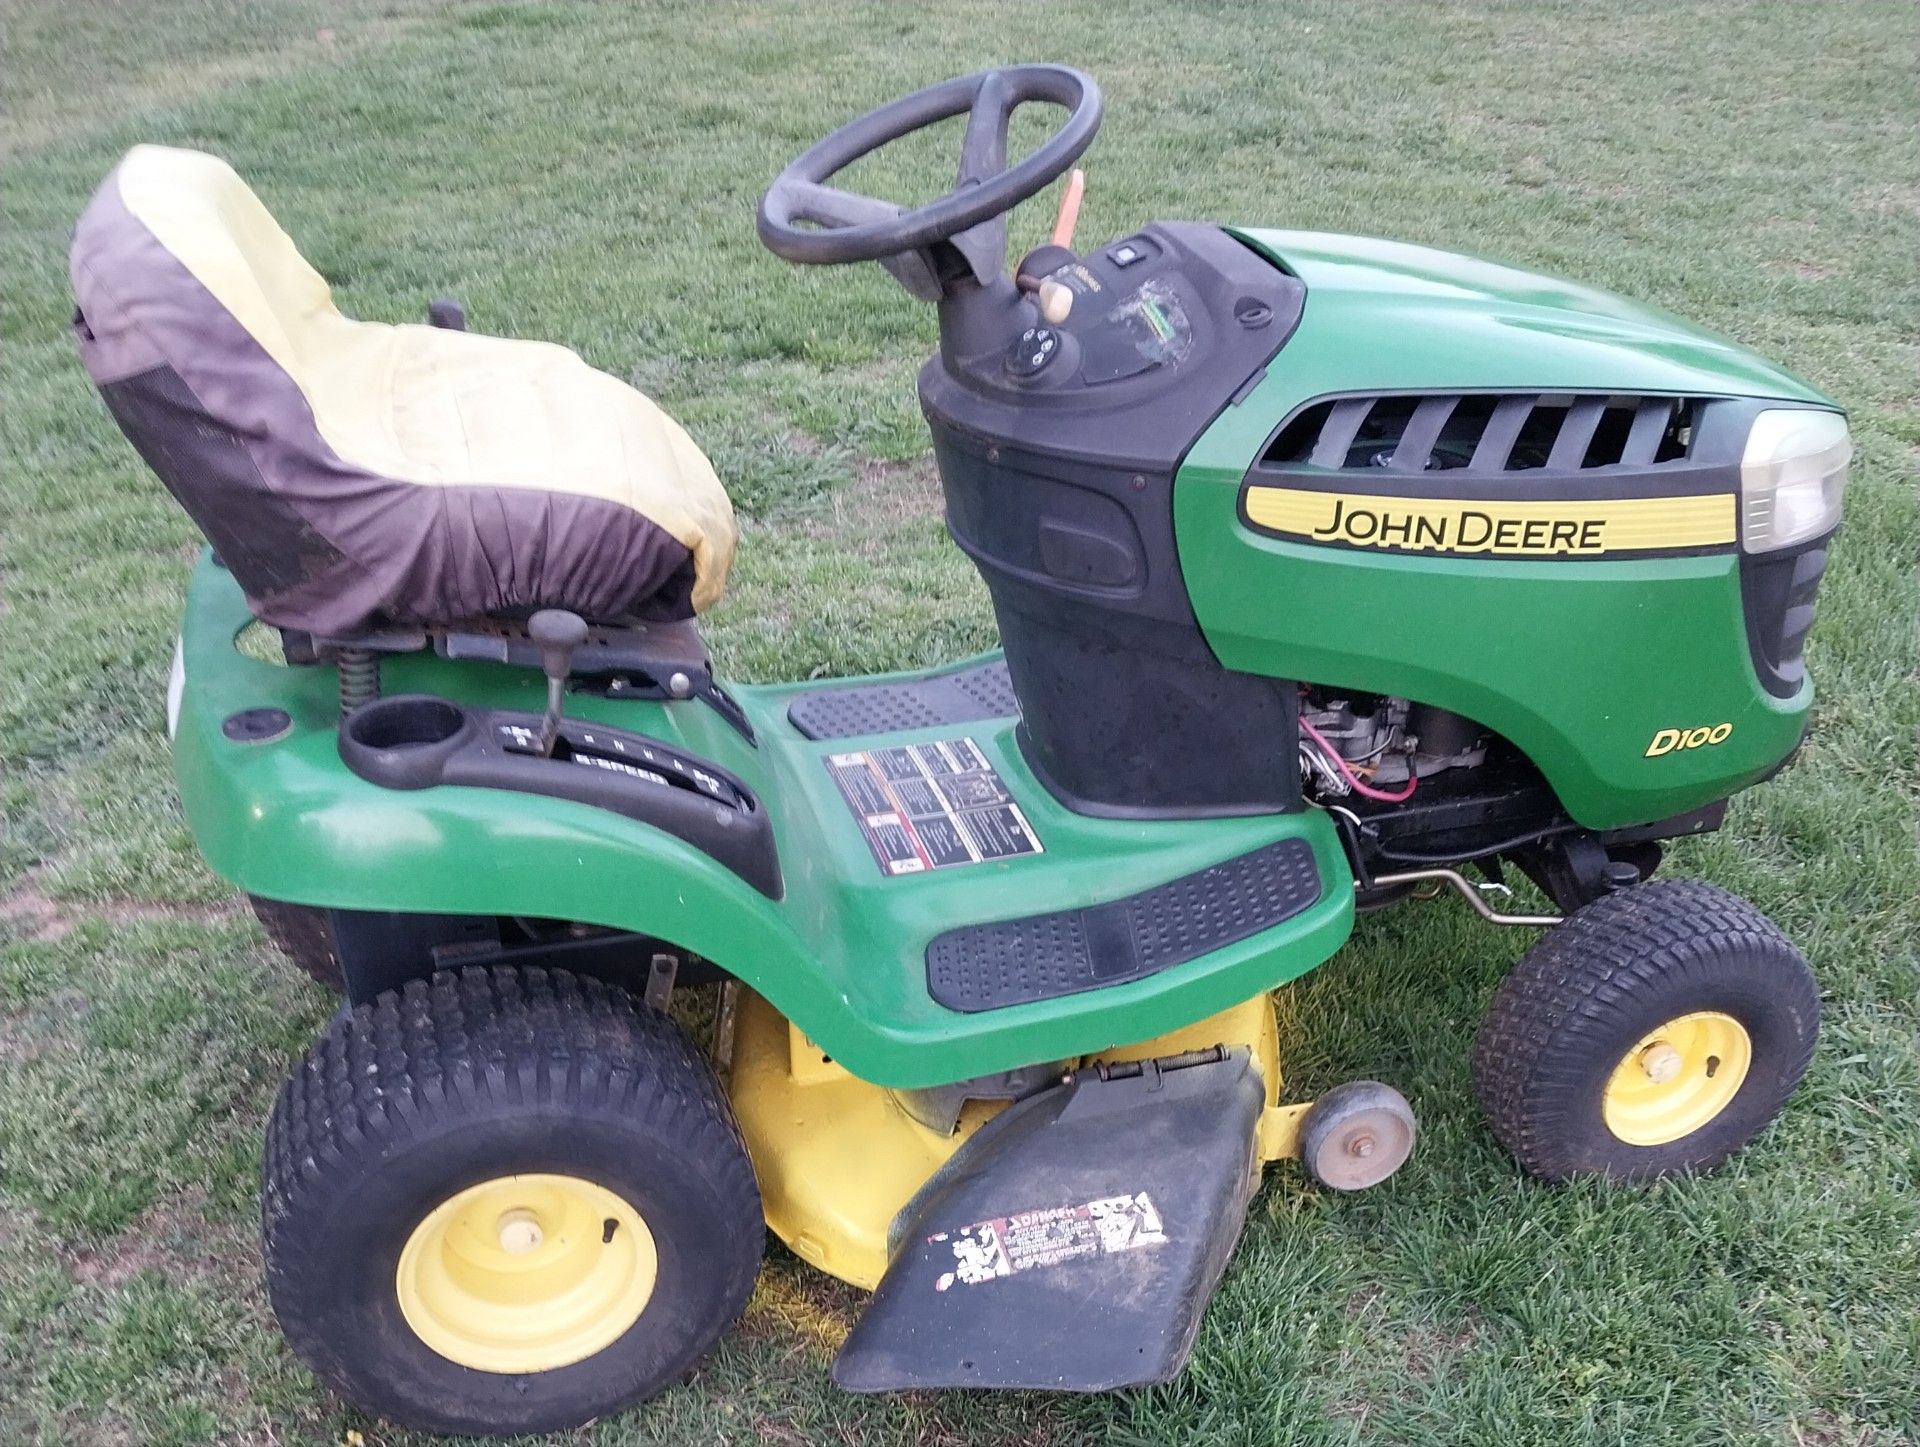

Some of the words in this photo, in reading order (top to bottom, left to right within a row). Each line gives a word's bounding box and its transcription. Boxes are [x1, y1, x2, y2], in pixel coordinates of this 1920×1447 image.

[1314, 499, 1447, 546] JOHN
[1456, 510, 1607, 549] DEERE
[1644, 721, 1734, 758] D100
